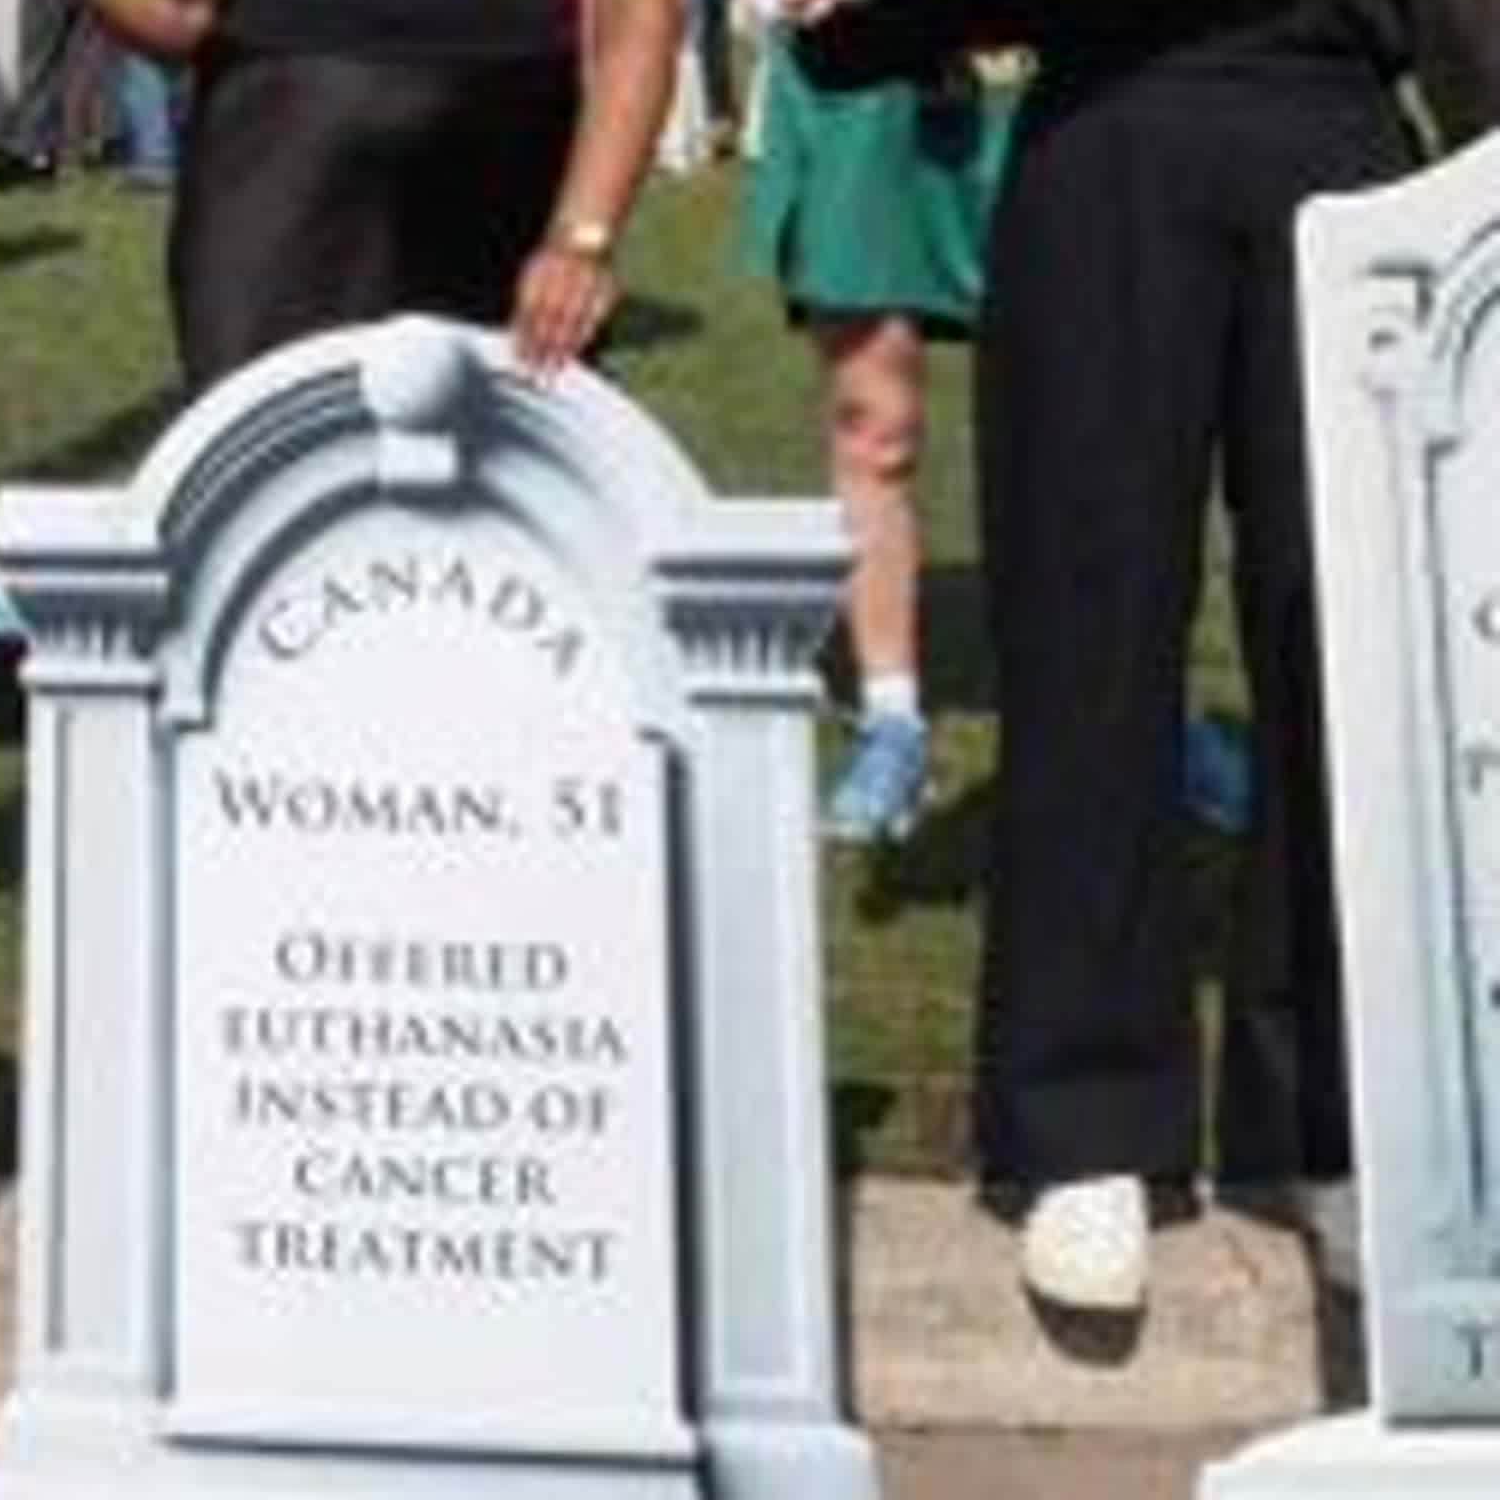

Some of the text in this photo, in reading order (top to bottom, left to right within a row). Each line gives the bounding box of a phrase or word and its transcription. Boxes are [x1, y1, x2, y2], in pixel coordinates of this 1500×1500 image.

[257, 556, 585, 677] CANADA
[553, 777, 623, 837] 51
[274, 930, 568, 991] OFFERED
[222, 1007, 629, 1066] EUTHANASIA
[236, 1077, 614, 1136] INSTEAD OF
[294, 1152, 556, 1205] CANCER
[232, 1221, 623, 1281] TREATMENT
